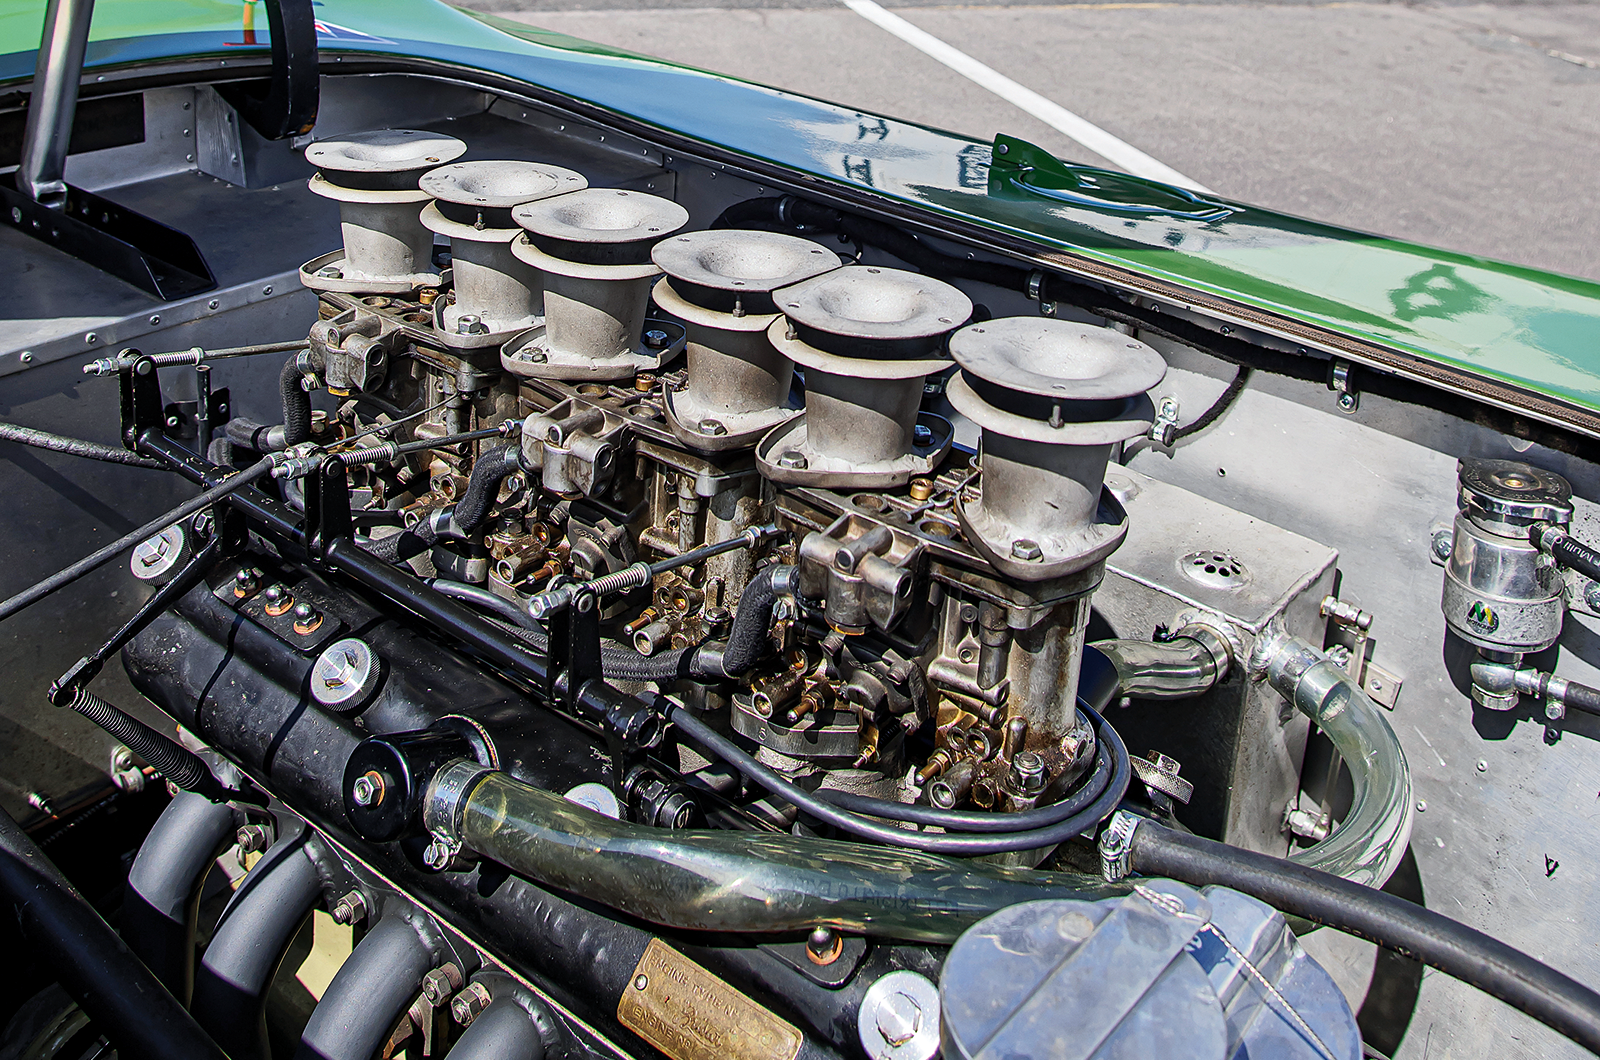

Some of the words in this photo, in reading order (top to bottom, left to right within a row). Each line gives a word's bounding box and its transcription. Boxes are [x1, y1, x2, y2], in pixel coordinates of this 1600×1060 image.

[650, 956, 690, 987] ENGINE
[692, 983, 723, 1009] TYPE
[633, 1003, 675, 1040] ENGINE
